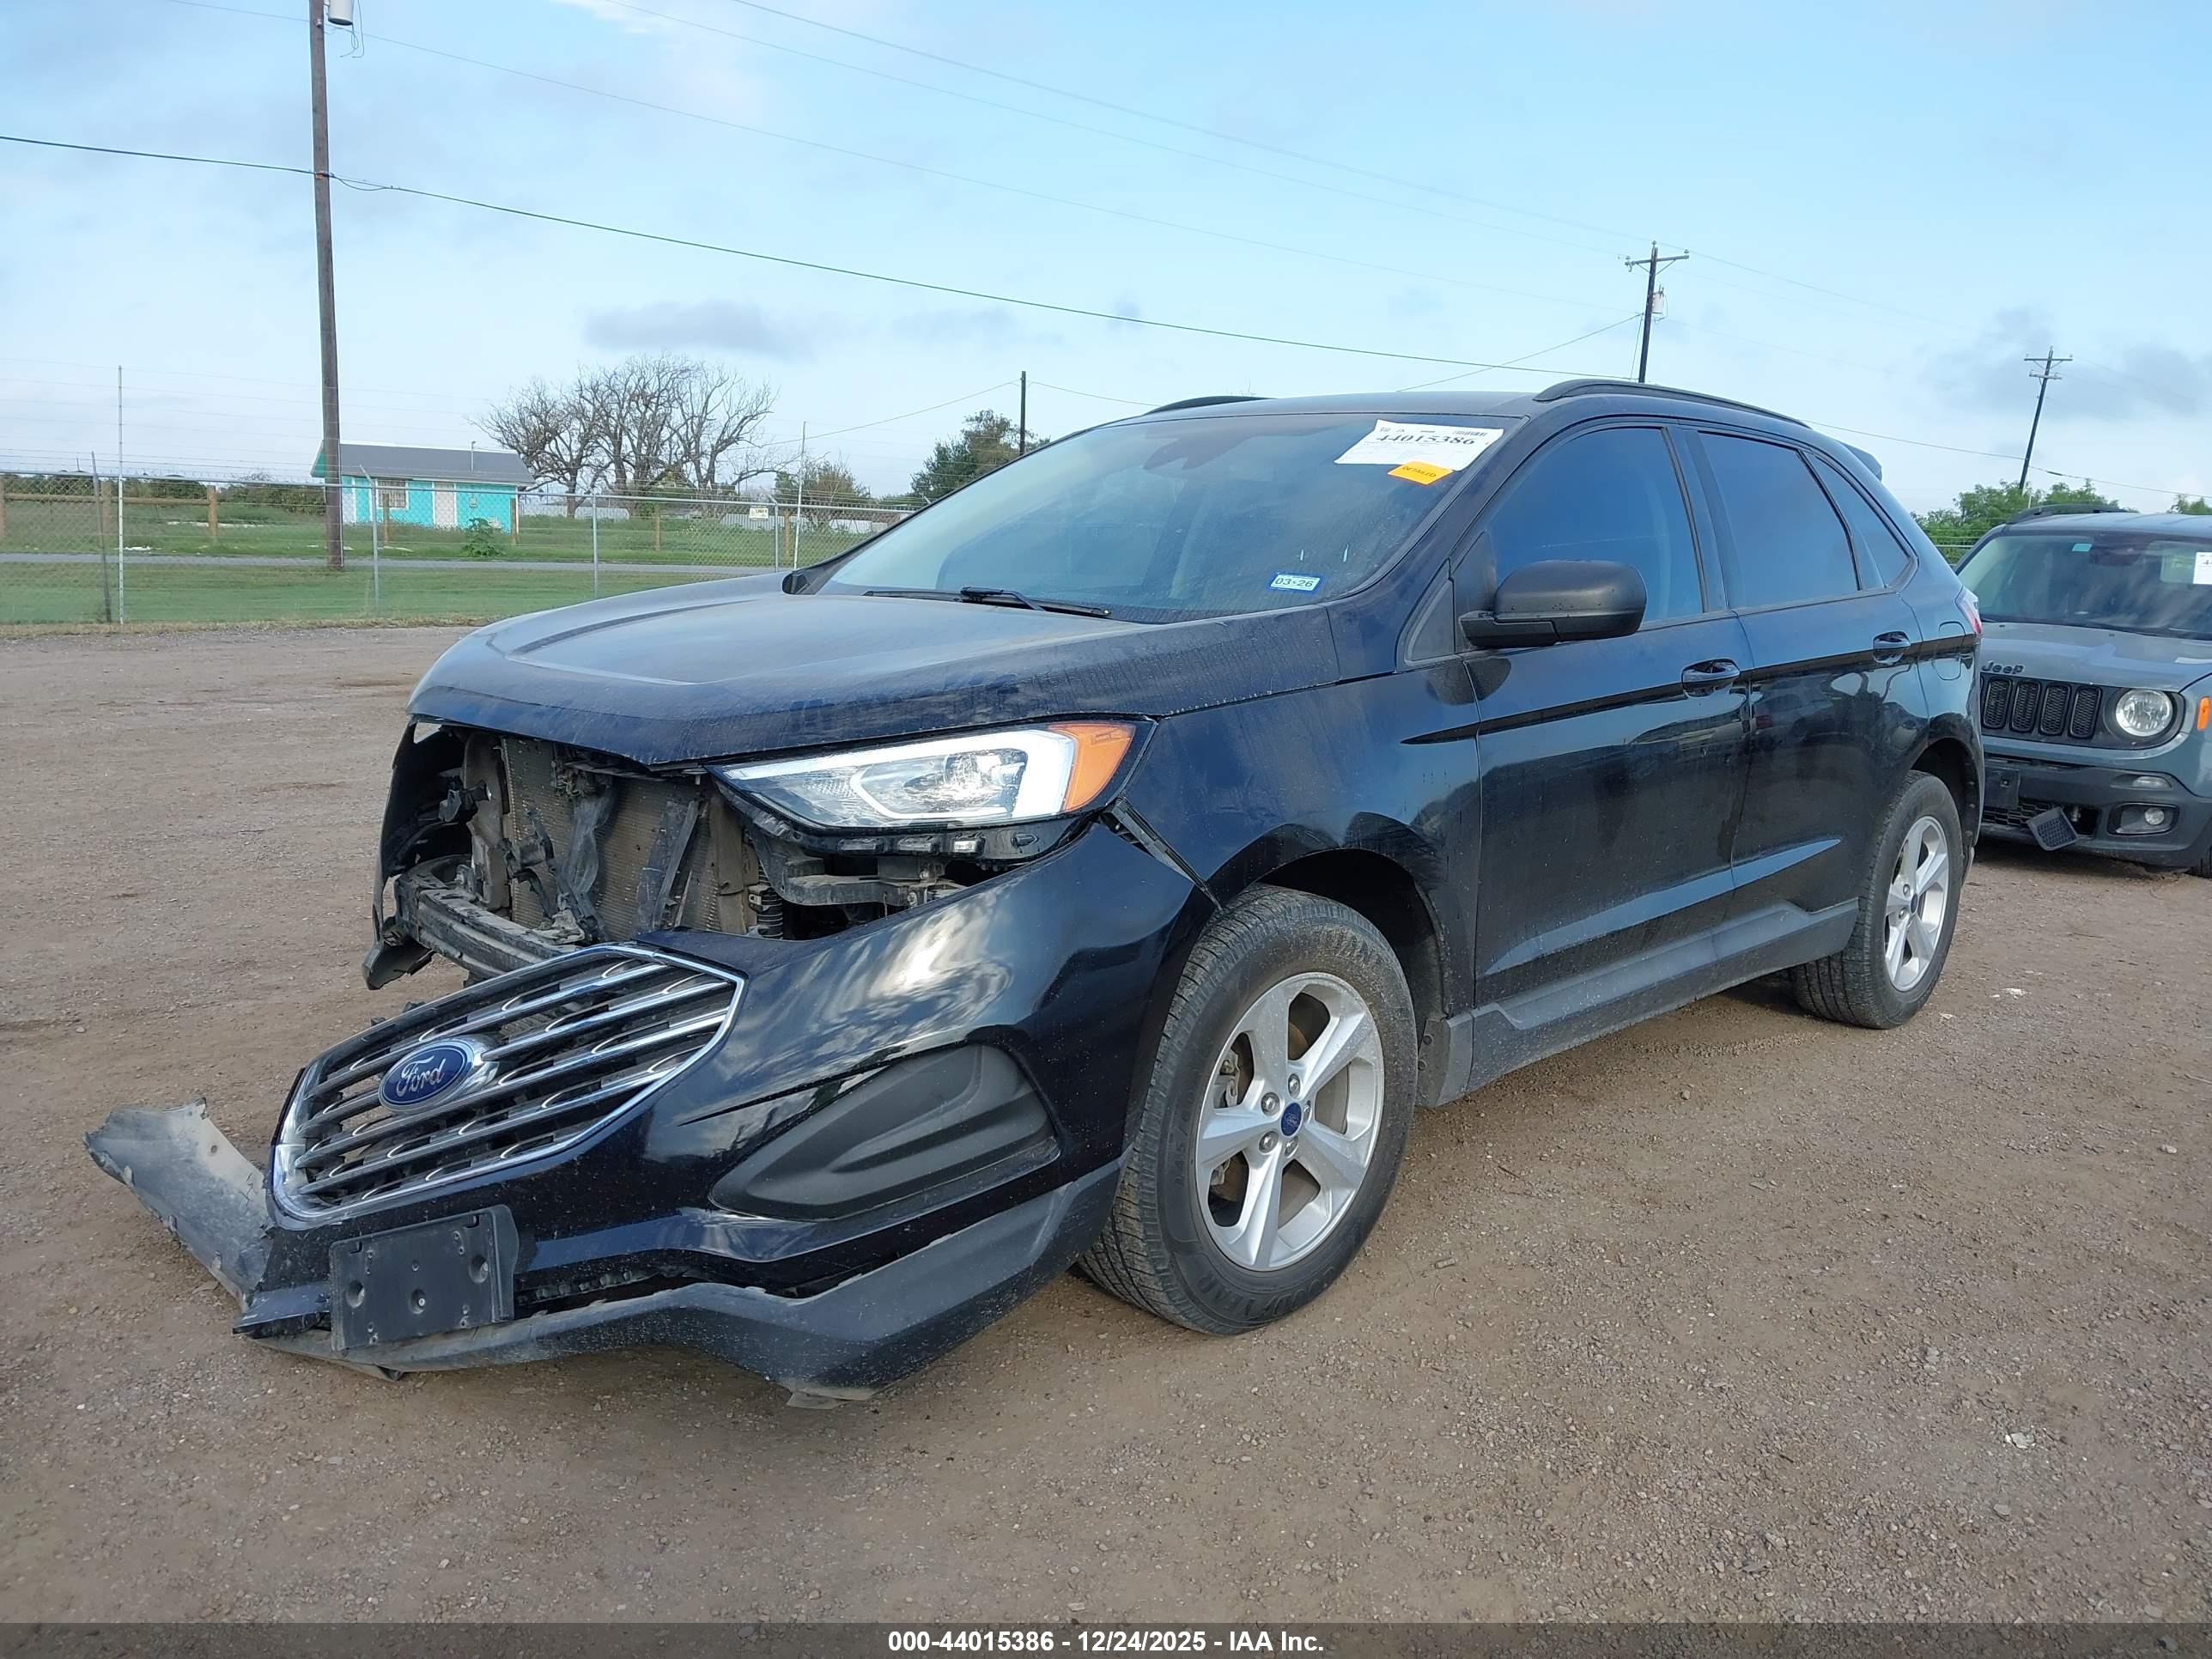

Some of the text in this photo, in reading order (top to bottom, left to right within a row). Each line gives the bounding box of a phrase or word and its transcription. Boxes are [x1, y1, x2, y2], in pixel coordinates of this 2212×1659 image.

[1376, 434, 1475, 445] 44015386
[1981, 661, 2024, 675] Jeep
[396, 1054, 447, 1097] Ford
